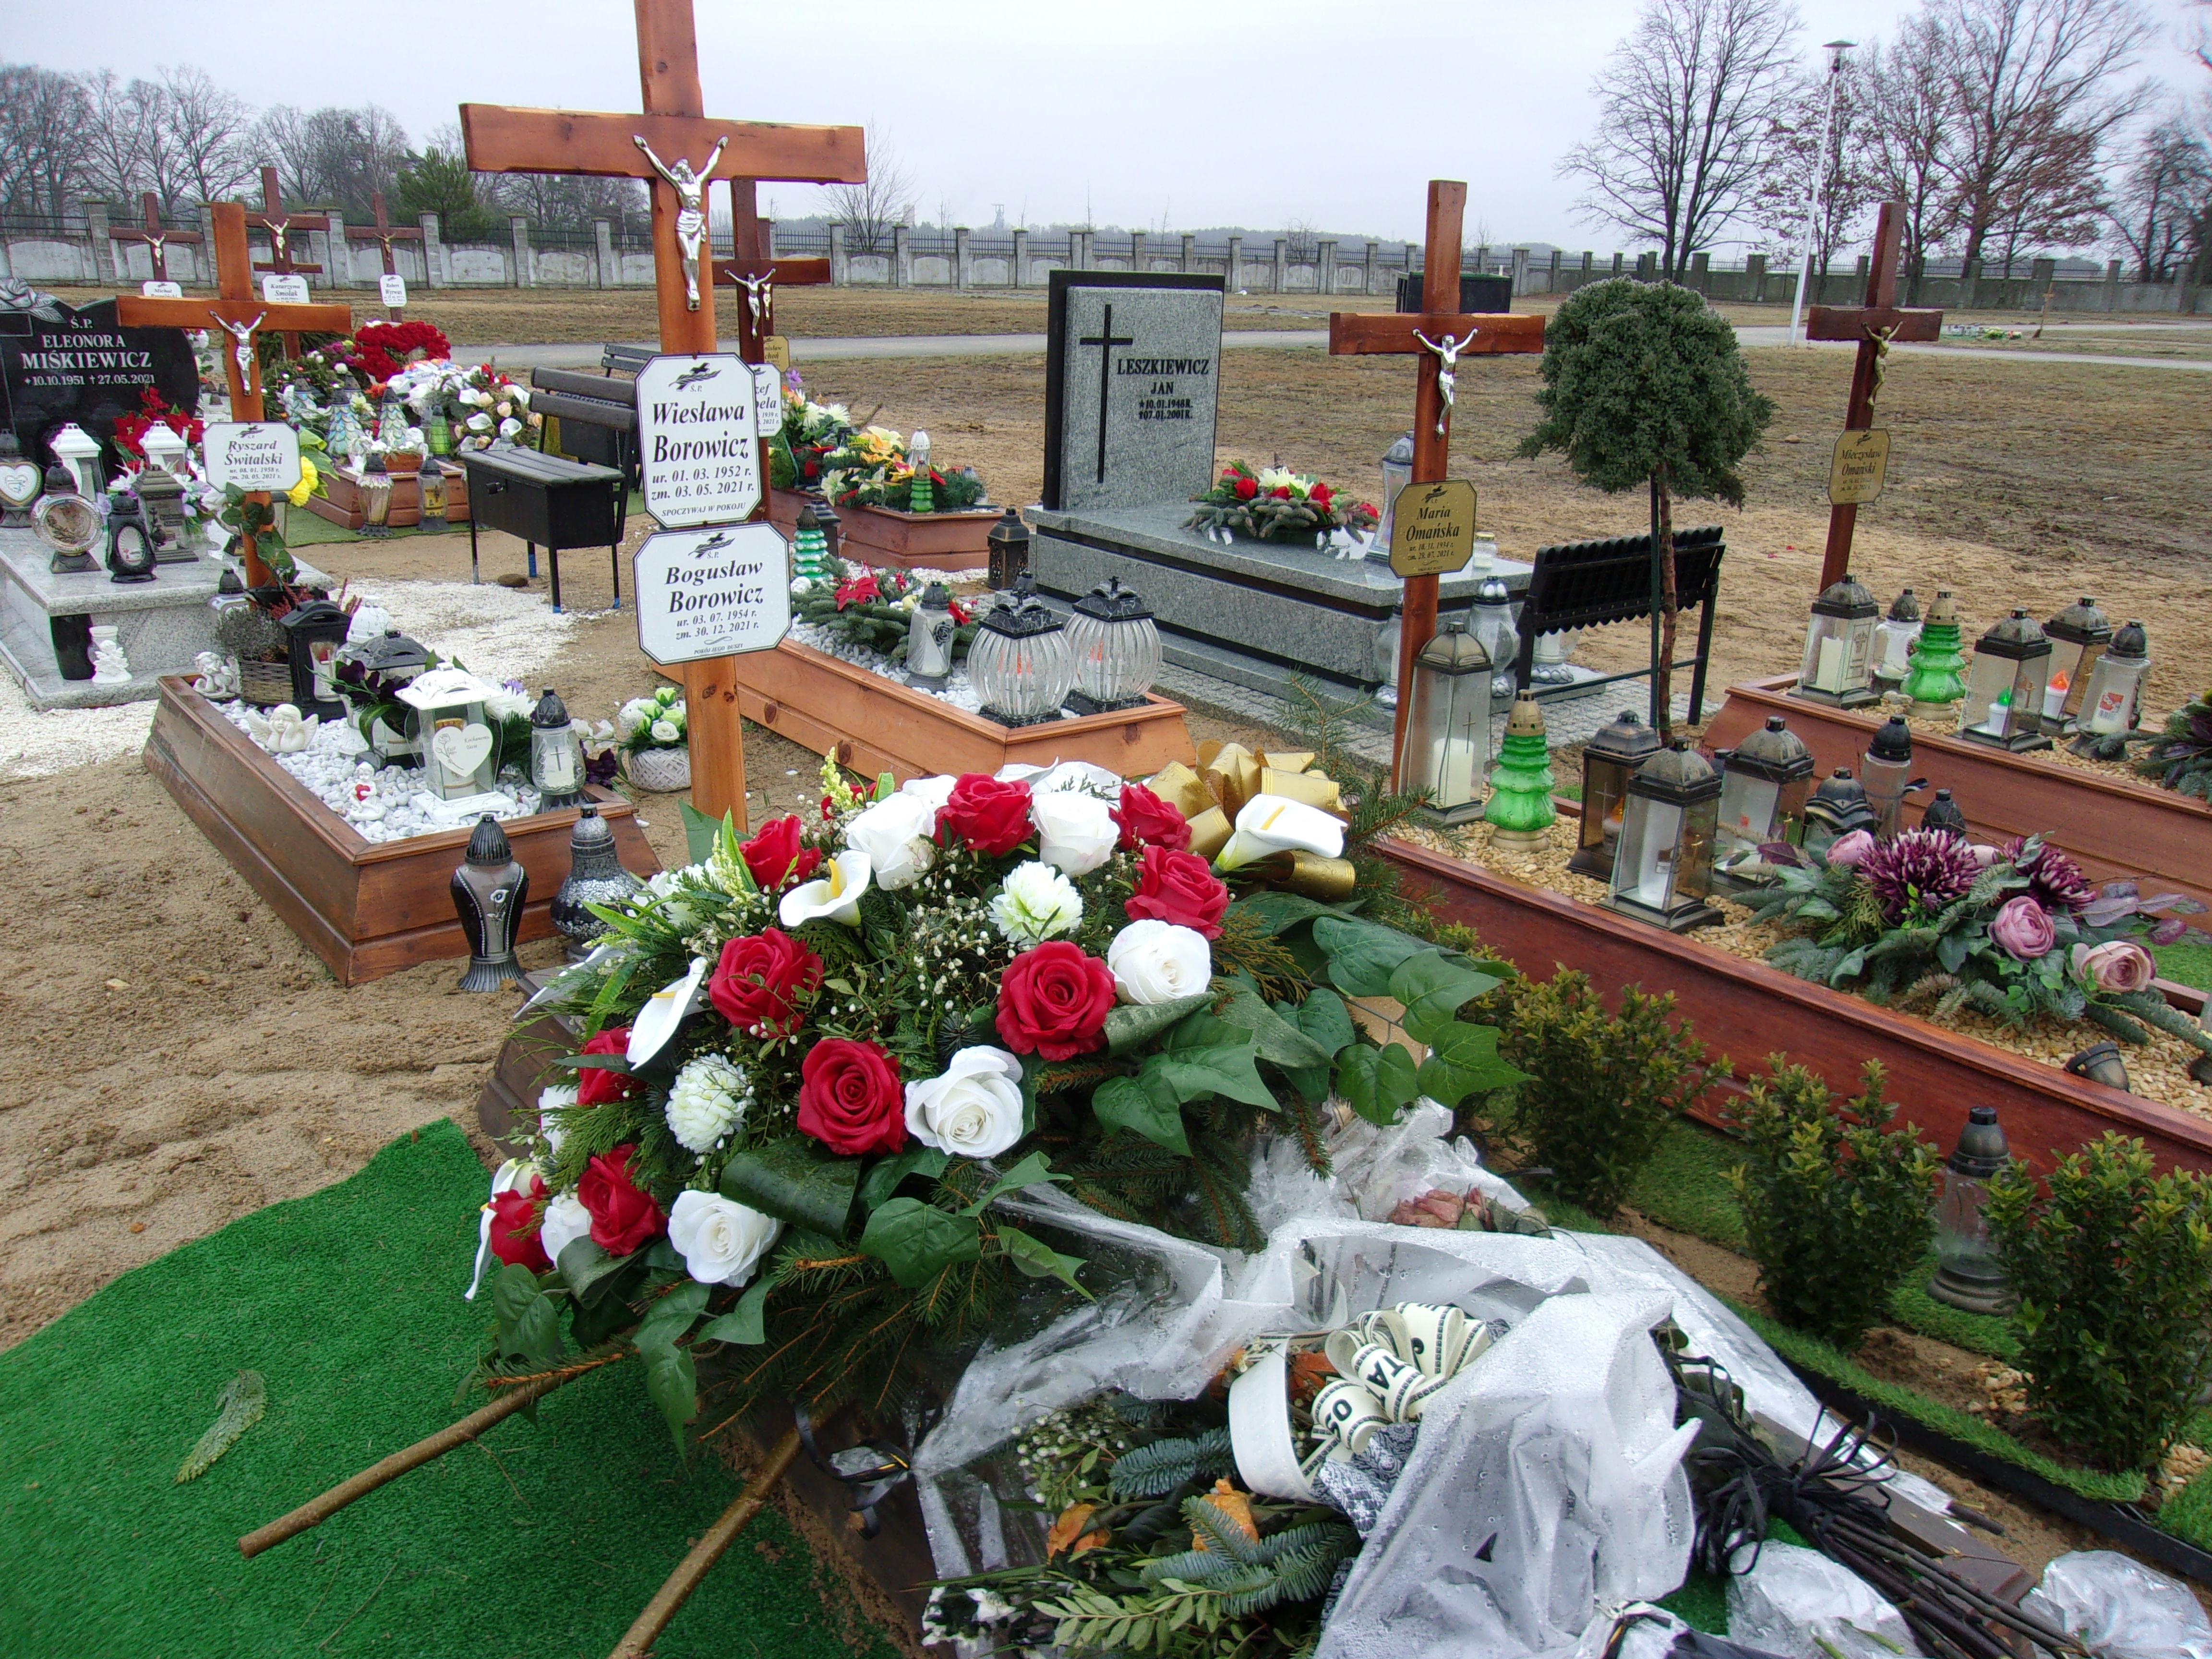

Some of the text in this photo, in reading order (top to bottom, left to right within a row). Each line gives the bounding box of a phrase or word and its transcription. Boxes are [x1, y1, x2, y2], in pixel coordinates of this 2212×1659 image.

[42, 335, 126, 348] ELEONORA
[20, 350, 152, 369] MIŚKIEWICZ
[1117, 359, 1209, 375] LESZKIEWICZ
[1151, 382, 1174, 395] JAN
[653, 401, 745, 425] Wiesława
[228, 441, 277, 452] Ryszard
[652, 430, 748, 463] Borowicz
[225, 449, 283, 465] Świtalski
[652, 474, 667, 484] ur.
[672, 470, 688, 482] 01.
[693, 469, 709, 480] 03.
[715, 466, 741, 479] 1952
[651, 481, 754, 501] zm. 03. 05. 2021 r.
[661, 505, 706, 517] SPOCZYWAJ
[716, 502, 746, 512] POKOJU
[1417, 505, 1450, 520] Maria
[1406, 522, 1460, 541] Omańska
[664, 560, 763, 586] Bogusław
[667, 583, 764, 613] Borowicz
[677, 619, 689, 627] ur.
[693, 615, 706, 625] 03.
[710, 613, 722, 622] 07.
[727, 609, 748, 620] 1954
[676, 632, 691, 640] zm.
[695, 627, 709, 637] 30.
[713, 625, 725, 634] 12.
[729, 621, 750, 632] 2021
